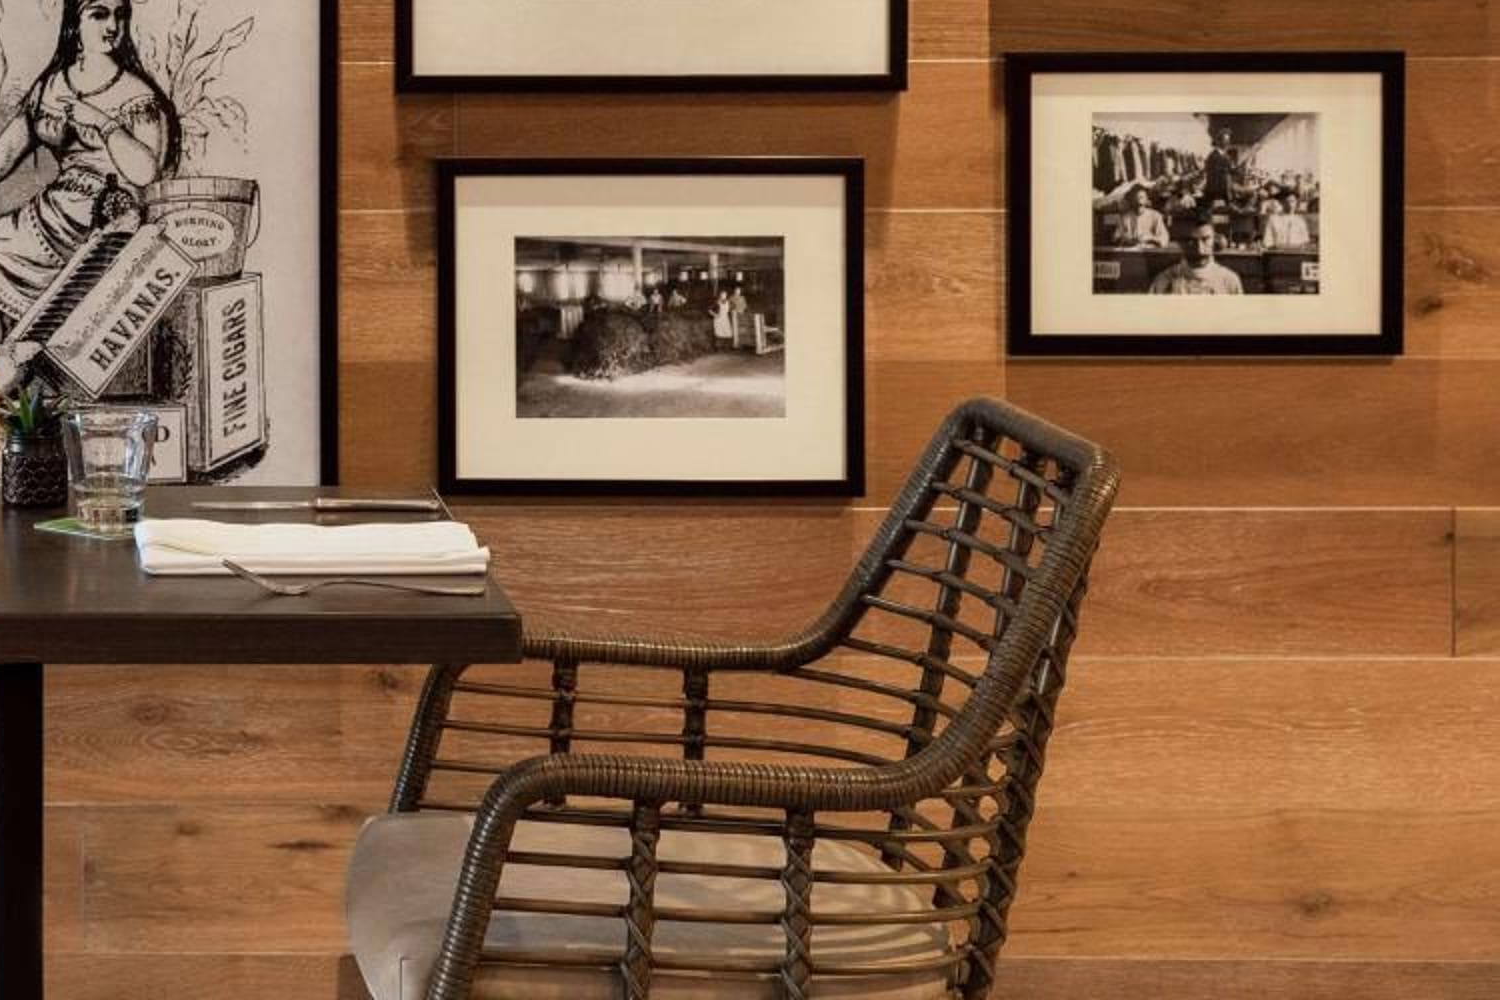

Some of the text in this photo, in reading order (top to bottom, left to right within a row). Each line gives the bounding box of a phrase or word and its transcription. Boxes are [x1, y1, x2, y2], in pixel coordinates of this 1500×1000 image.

[89, 267, 181, 371] HAVANAS.
[221, 297, 247, 438] FINE CIGARS
